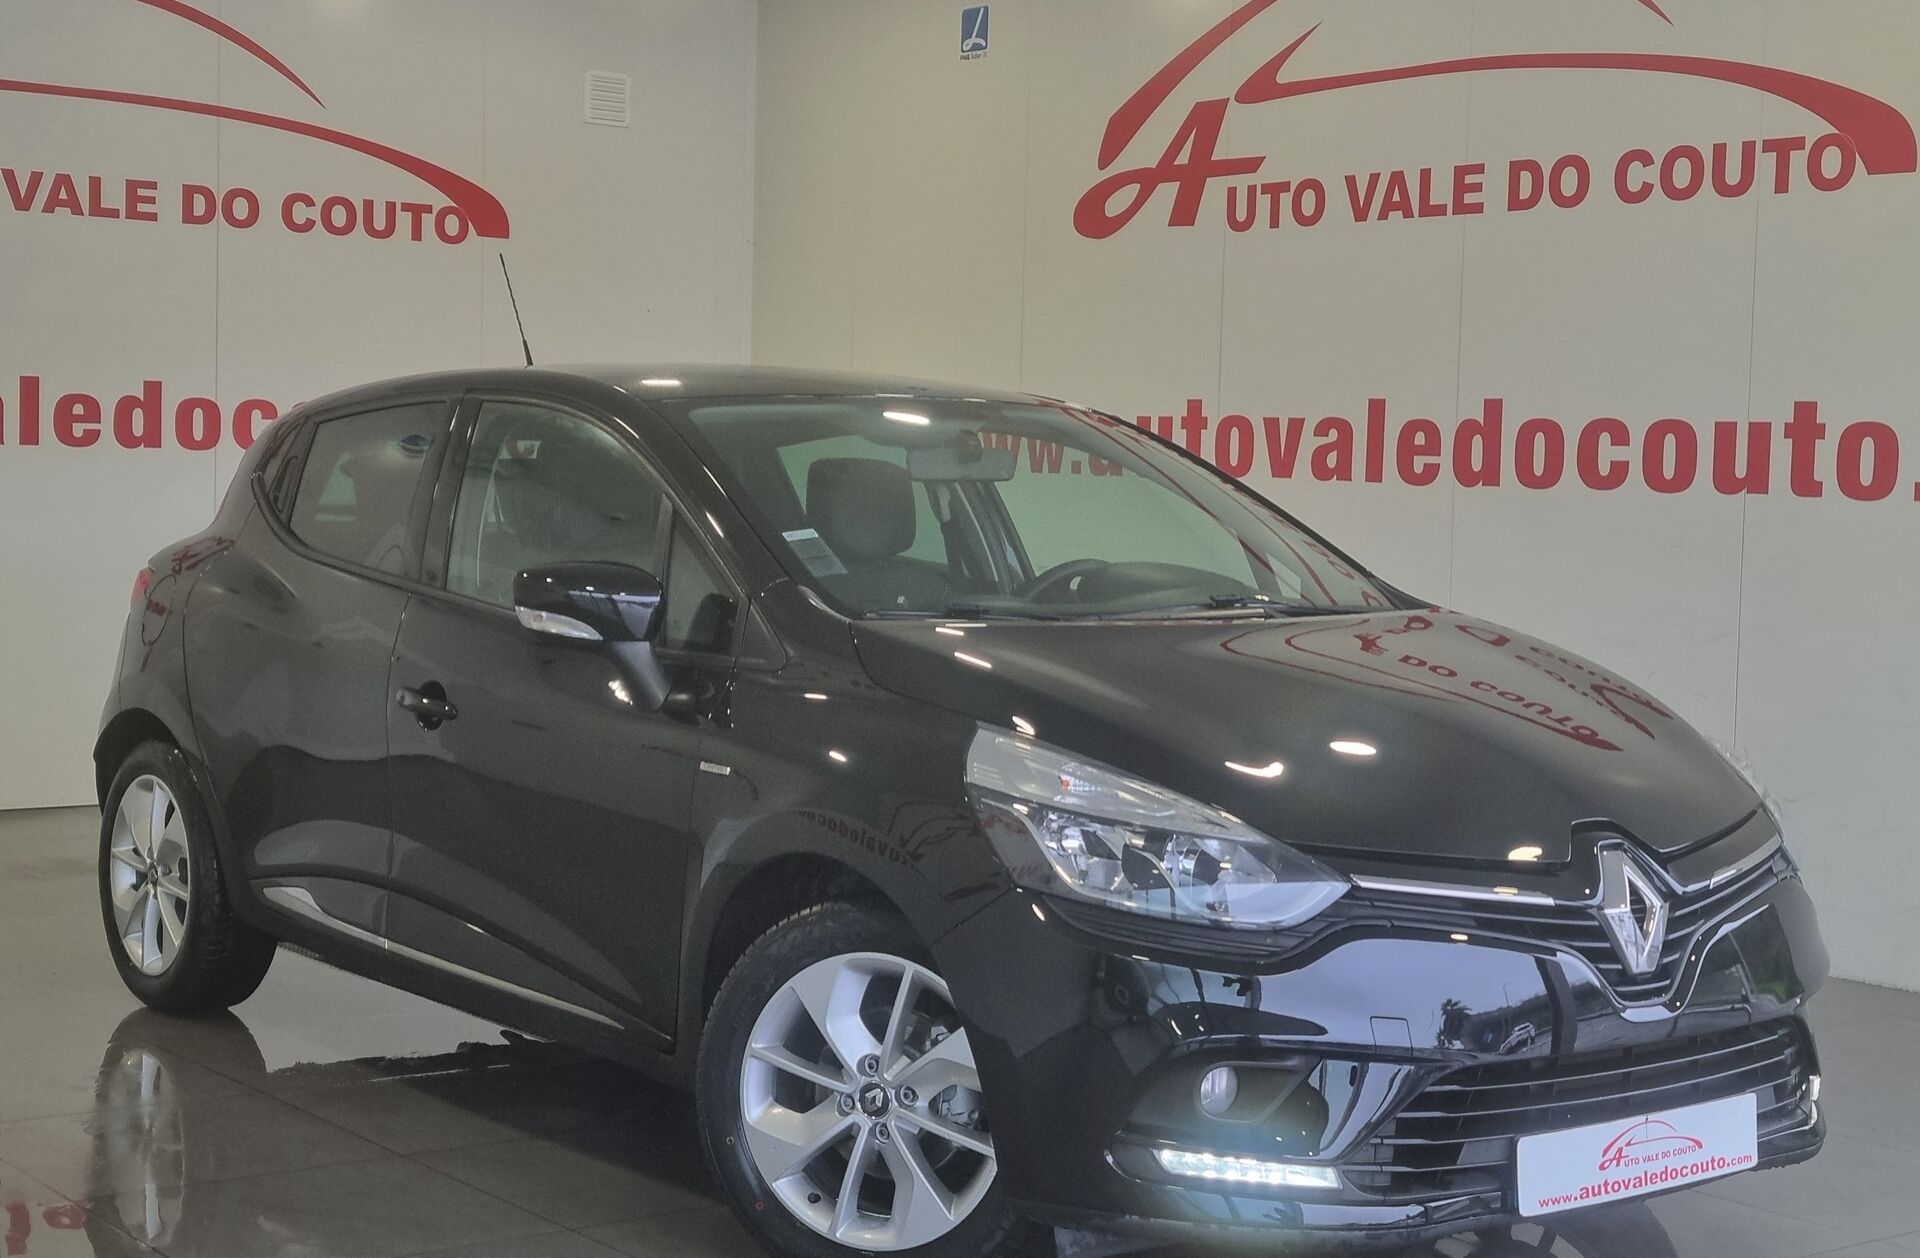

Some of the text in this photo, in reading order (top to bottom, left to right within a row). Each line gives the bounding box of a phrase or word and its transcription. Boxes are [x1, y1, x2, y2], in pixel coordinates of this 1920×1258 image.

[1, 167, 471, 245] VALE DO COUTO
[1074, 98, 1857, 240] AUTO VALE DO COUTO
[0, 375, 304, 452] ledoc
[1538, 1152, 1753, 1208] www.autovaledocouto.com
[1599, 1145, 1697, 1171] AUTO VALE DO COUTO
